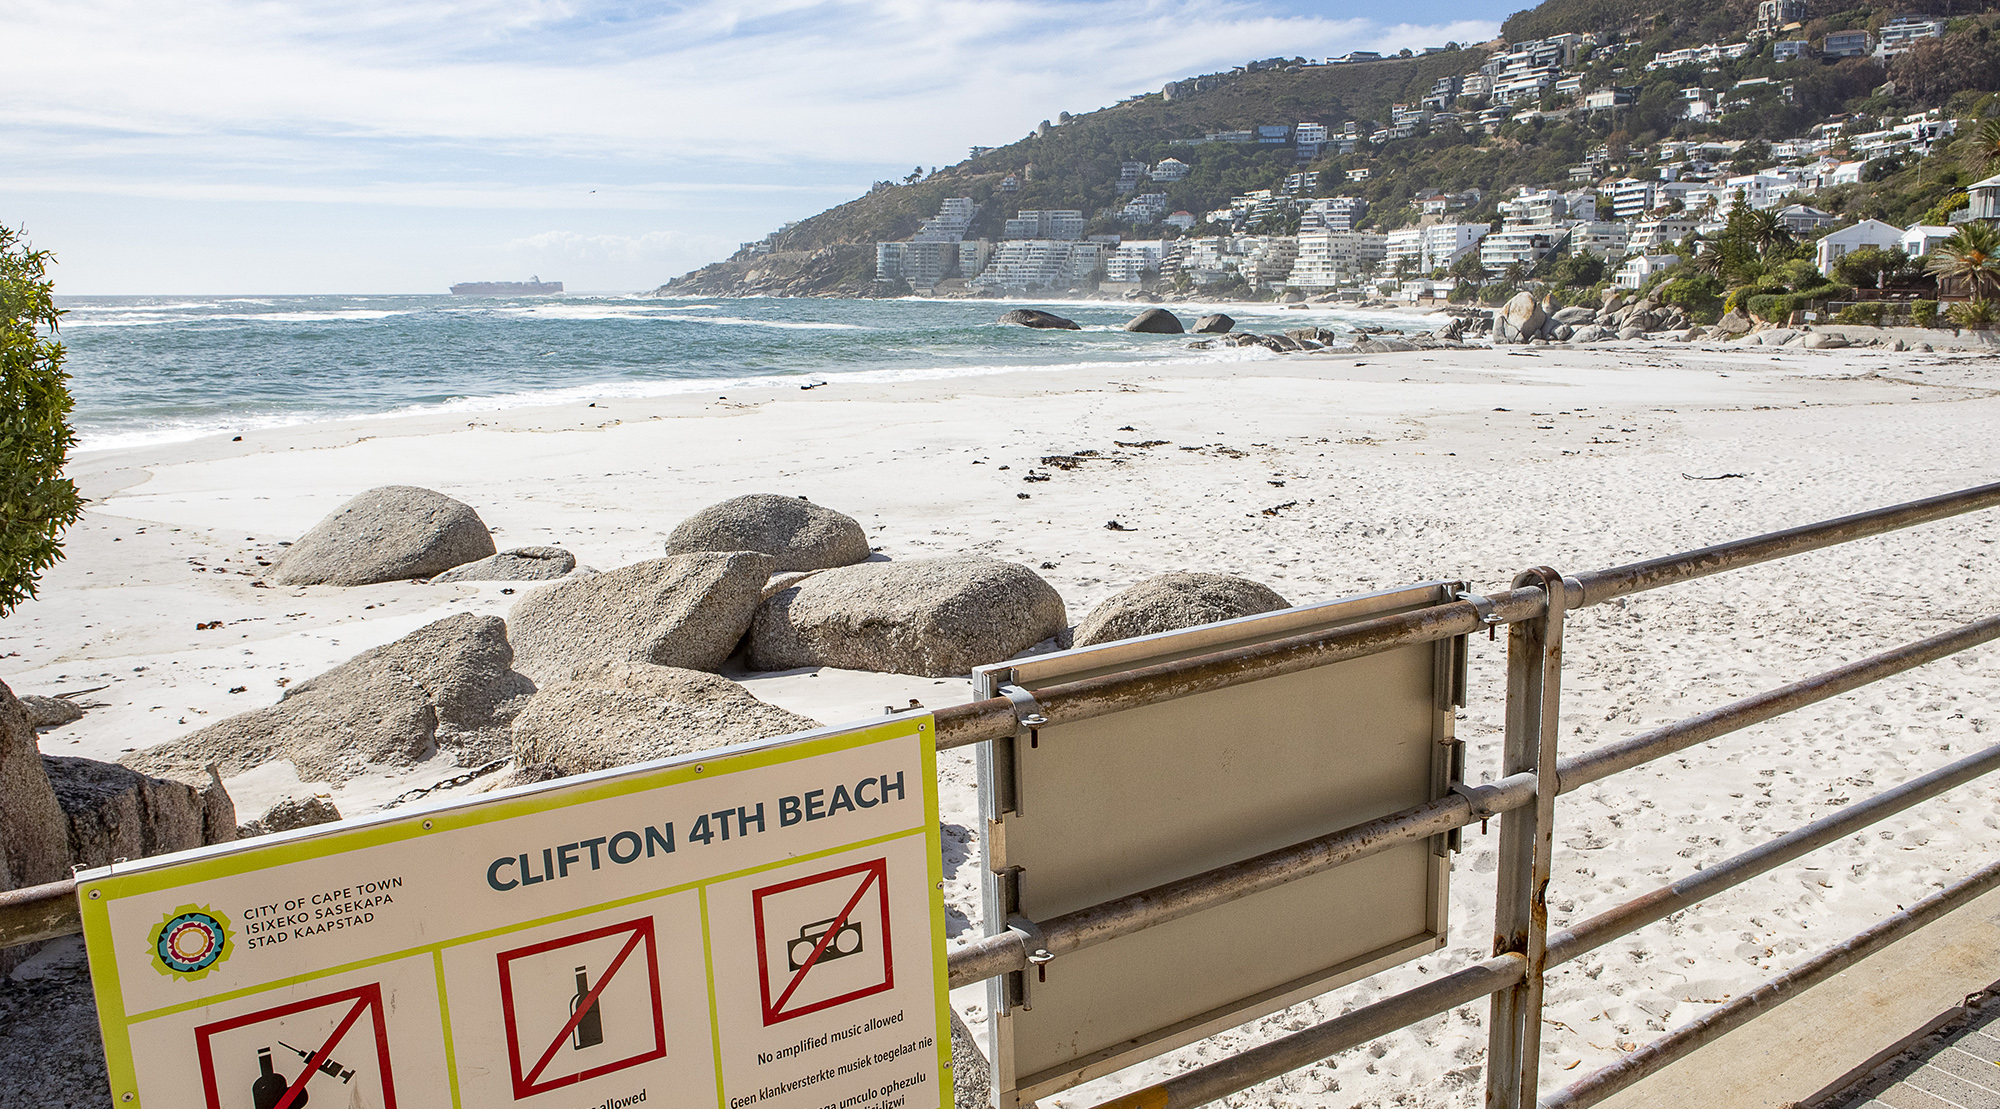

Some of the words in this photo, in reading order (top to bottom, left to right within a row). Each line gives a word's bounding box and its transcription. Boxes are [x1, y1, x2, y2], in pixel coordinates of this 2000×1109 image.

[487, 822, 676, 891] CLIFTON
[688, 802, 765, 845] 4TH
[778, 771, 906, 827] BEACH
[243, 903, 279, 920] CITY
[284, 897, 306, 911] OF
[311, 888, 352, 905] CAPE
[356, 876, 403, 896] TOWN
[245, 912, 309, 935] ISIXEKO
[315, 894, 394, 920] SASEKAPA
[247, 932, 288, 949] STAD
[294, 912, 375, 939] KAAPSTAD
[757, 1053, 773, 1066] No
[776, 1033, 828, 1060] amplified
[830, 1026, 861, 1043] music
[864, 1010, 904, 1033] allowed
[730, 1094, 757, 1109] Geen
[759, 1069, 835, 1101] klankversterkte
[837, 1055, 872, 1076] musiek
[874, 1041, 917, 1064] toegelaat
[918, 1036, 933, 1050] nie
[839, 1089, 878, 1109] umculo
[880, 1072, 926, 1096] ophezulu
[600, 1088, 647, 1109] allowed
